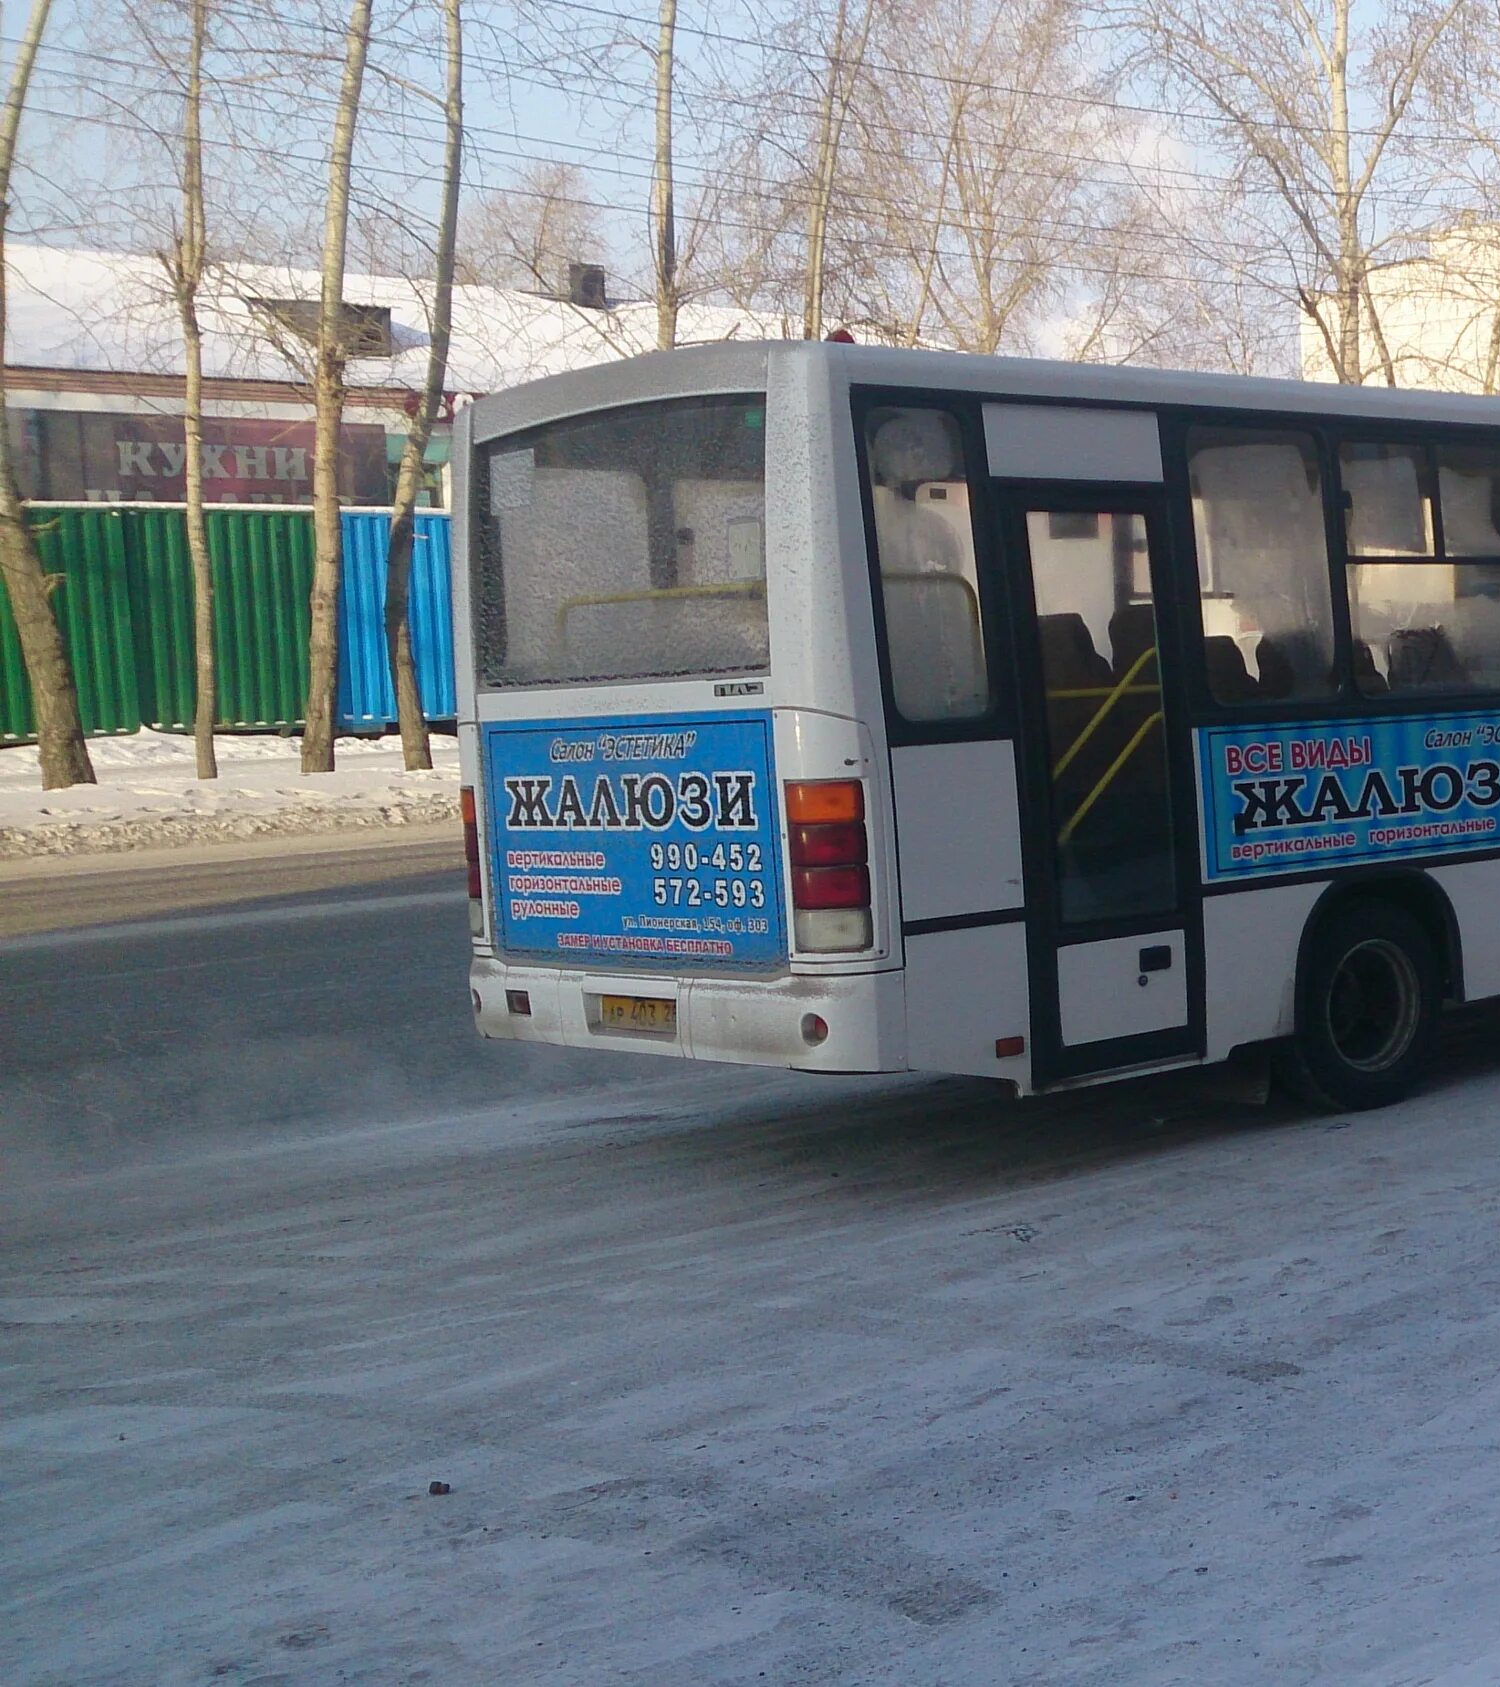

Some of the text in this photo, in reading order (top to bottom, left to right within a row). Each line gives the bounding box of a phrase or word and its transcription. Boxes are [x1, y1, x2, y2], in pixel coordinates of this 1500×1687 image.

[116, 440, 309, 481] КУХНИ
[551, 737, 595, 763] Салон
[1424, 728, 1472, 749] Салон
[1226, 736, 1371, 775] ВСЕ ВИДЫ
[505, 773, 757, 831] ЖАЛЮЗИ
[1231, 831, 1356, 861] вертикальные
[1368, 817, 1496, 846] горизонтальные
[507, 851, 605, 872] вертикальные
[651, 843, 762, 871] 990-452
[509, 875, 622, 896] горизонтальные
[654, 878, 765, 908] 572-593
[511, 899, 579, 920] рулонные
[622, 915, 637, 931] ул.
[639, 914, 701, 933] Пионерская,
[727, 918, 746, 935] оф.
[748, 918, 768, 934] 303
[557, 933, 733, 956] ЗАМЕР И УСТАНОВКА БЕСПЛАТНО
